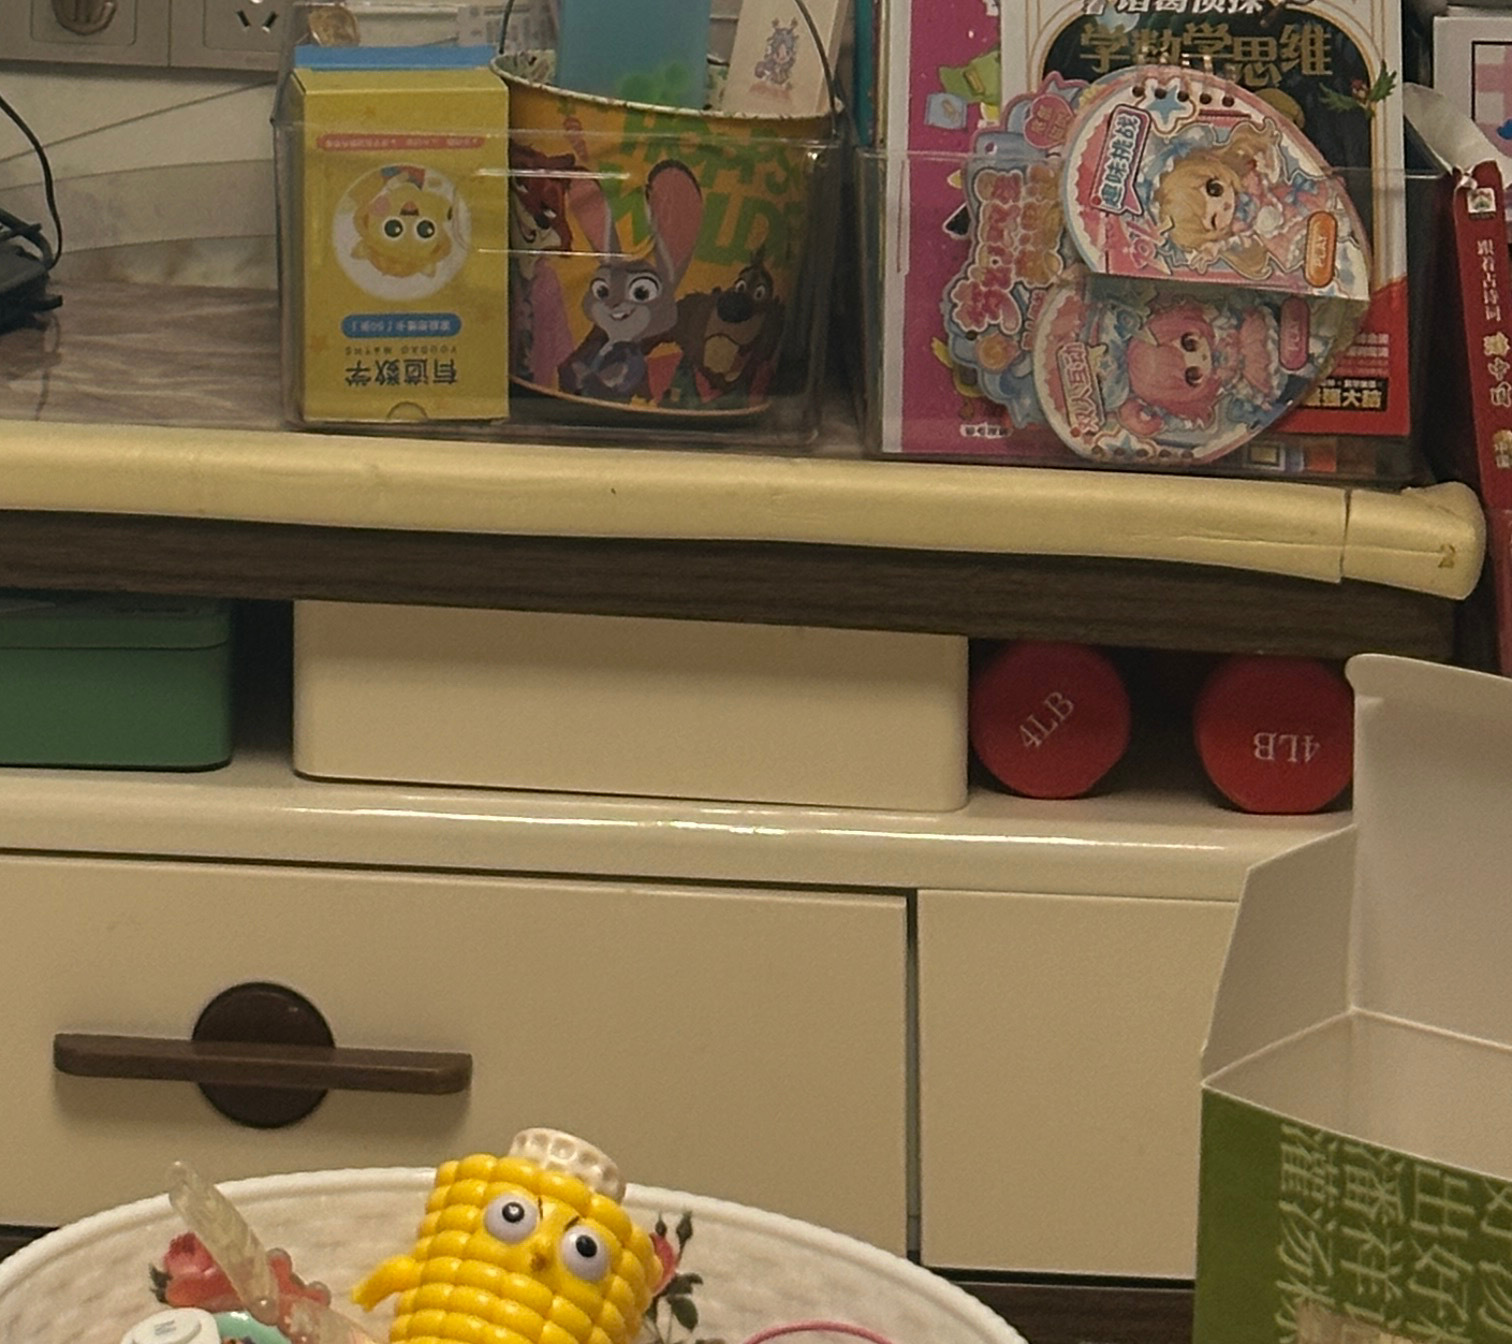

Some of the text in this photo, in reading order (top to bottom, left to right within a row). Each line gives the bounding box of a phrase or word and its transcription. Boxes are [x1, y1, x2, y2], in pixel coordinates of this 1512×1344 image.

[1079, 20, 1334, 87] 学数学思维
[1100, 114, 1140, 209] 趣味挑战
[344, 358, 458, 387] 有道数学
[1017, 690, 1076, 750] 4LB
[1252, 731, 1321, 763] 4LB
